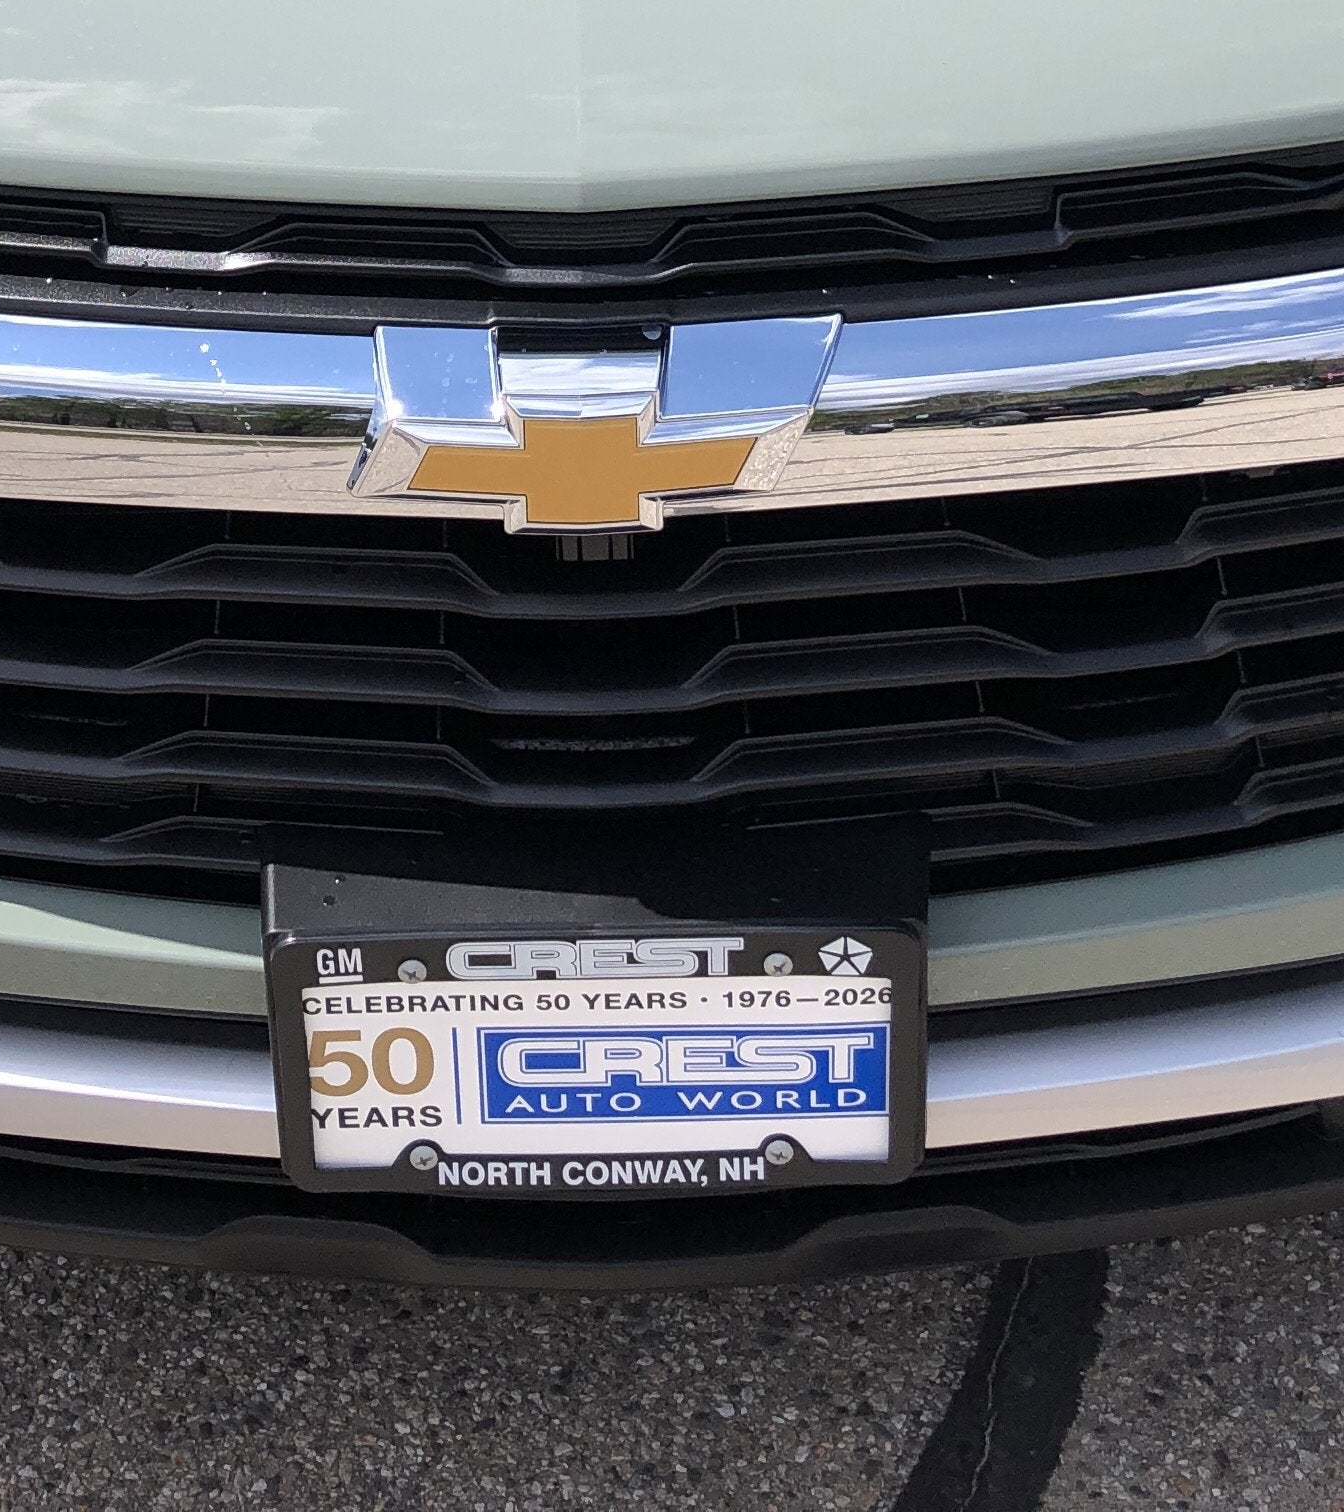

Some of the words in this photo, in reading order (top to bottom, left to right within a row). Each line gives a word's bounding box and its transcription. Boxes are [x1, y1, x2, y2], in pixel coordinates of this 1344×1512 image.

[316, 947, 364, 978] GM
[445, 937, 744, 981] CREST
[302, 993, 525, 1015] CELEBRATING
[535, 993, 571, 1011] 50
[581, 991, 688, 1011] YEARS
[309, 1026, 435, 1097] 50
[497, 1033, 874, 1088] CREST
[505, 1091, 642, 1113] AUTO
[677, 1088, 867, 1111] WORLD
[311, 1105, 443, 1129] YEARS
[437, 1161, 552, 1186] NORTH
[562, 1159, 708, 1187] CONWAY,
[719, 1156, 765, 1181] NH
